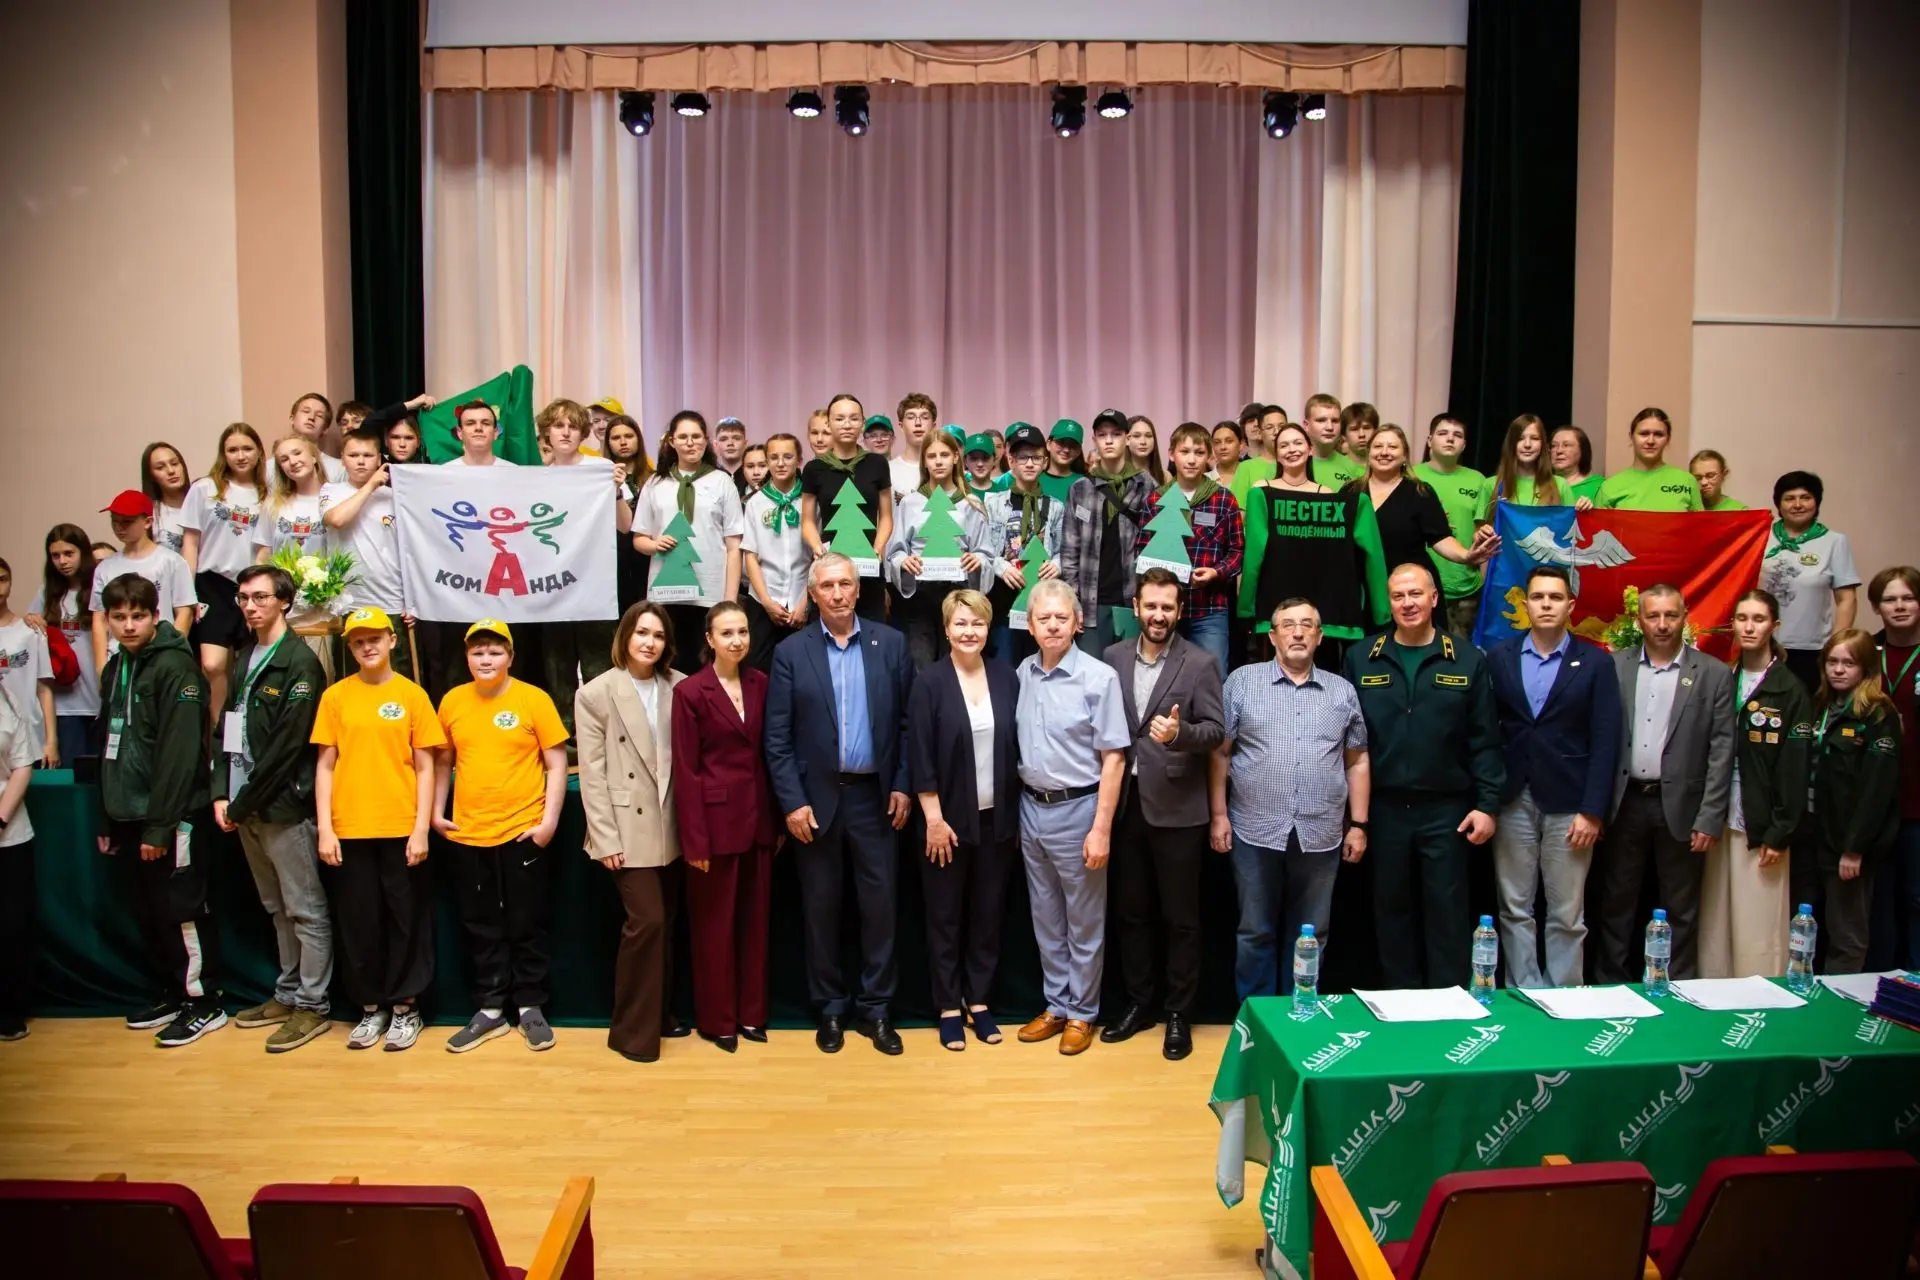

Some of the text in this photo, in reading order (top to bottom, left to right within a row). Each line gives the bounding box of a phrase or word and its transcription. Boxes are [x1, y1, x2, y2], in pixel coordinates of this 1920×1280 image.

[435, 552, 577, 596] КОМАНДА
[1302, 1043, 1344, 1070] УГЛТУ
[1476, 1099, 1529, 1159] УГЛТУ
[1619, 1090, 1673, 1149] УГЛТУ
[1758, 1081, 1811, 1139] УГЛТУ
[1331, 1110, 1385, 1170] УГЛТУ
